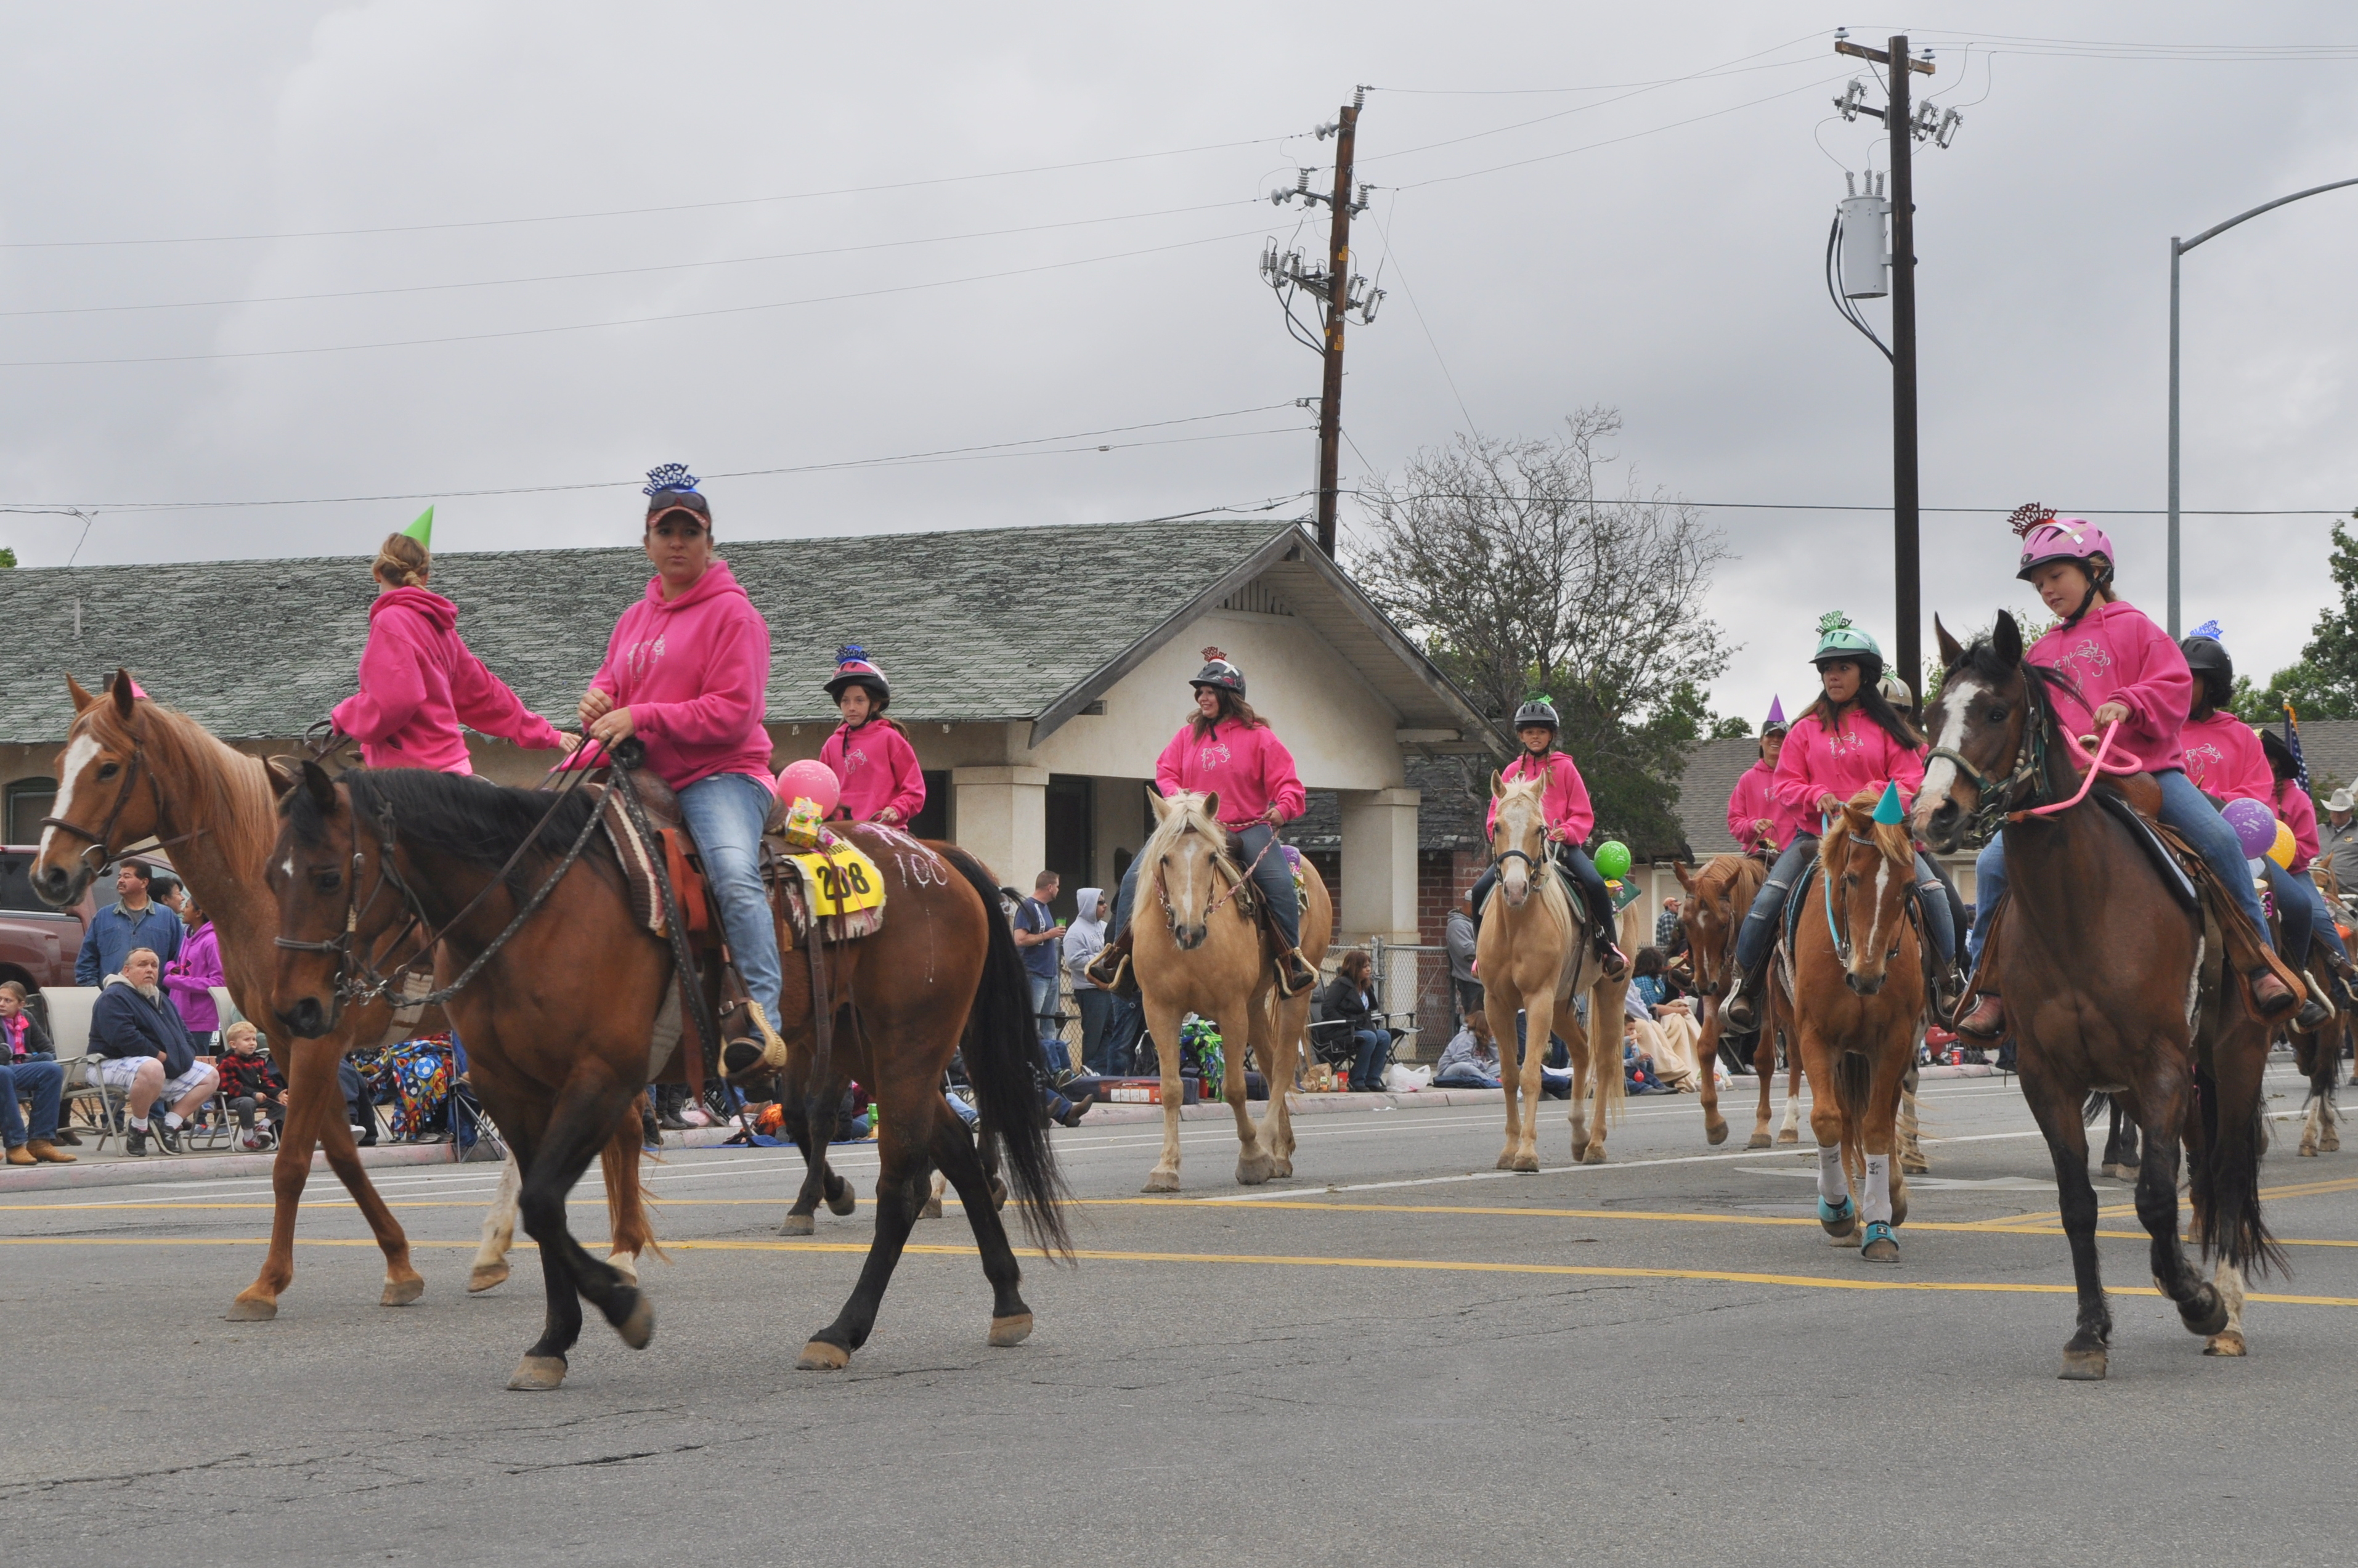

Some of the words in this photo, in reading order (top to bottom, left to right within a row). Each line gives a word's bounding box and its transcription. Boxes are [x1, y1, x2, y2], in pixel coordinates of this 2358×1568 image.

[646, 463, 689, 481] HAPPY
[643, 474, 700, 497] BIRTHDAY
[2007, 502, 2040, 524] HAPPY
[2012, 508, 2057, 535] BIRTHDAY
[1819, 611, 1844, 623] HAPPY
[2199, 620, 2218, 632] HAPPY
